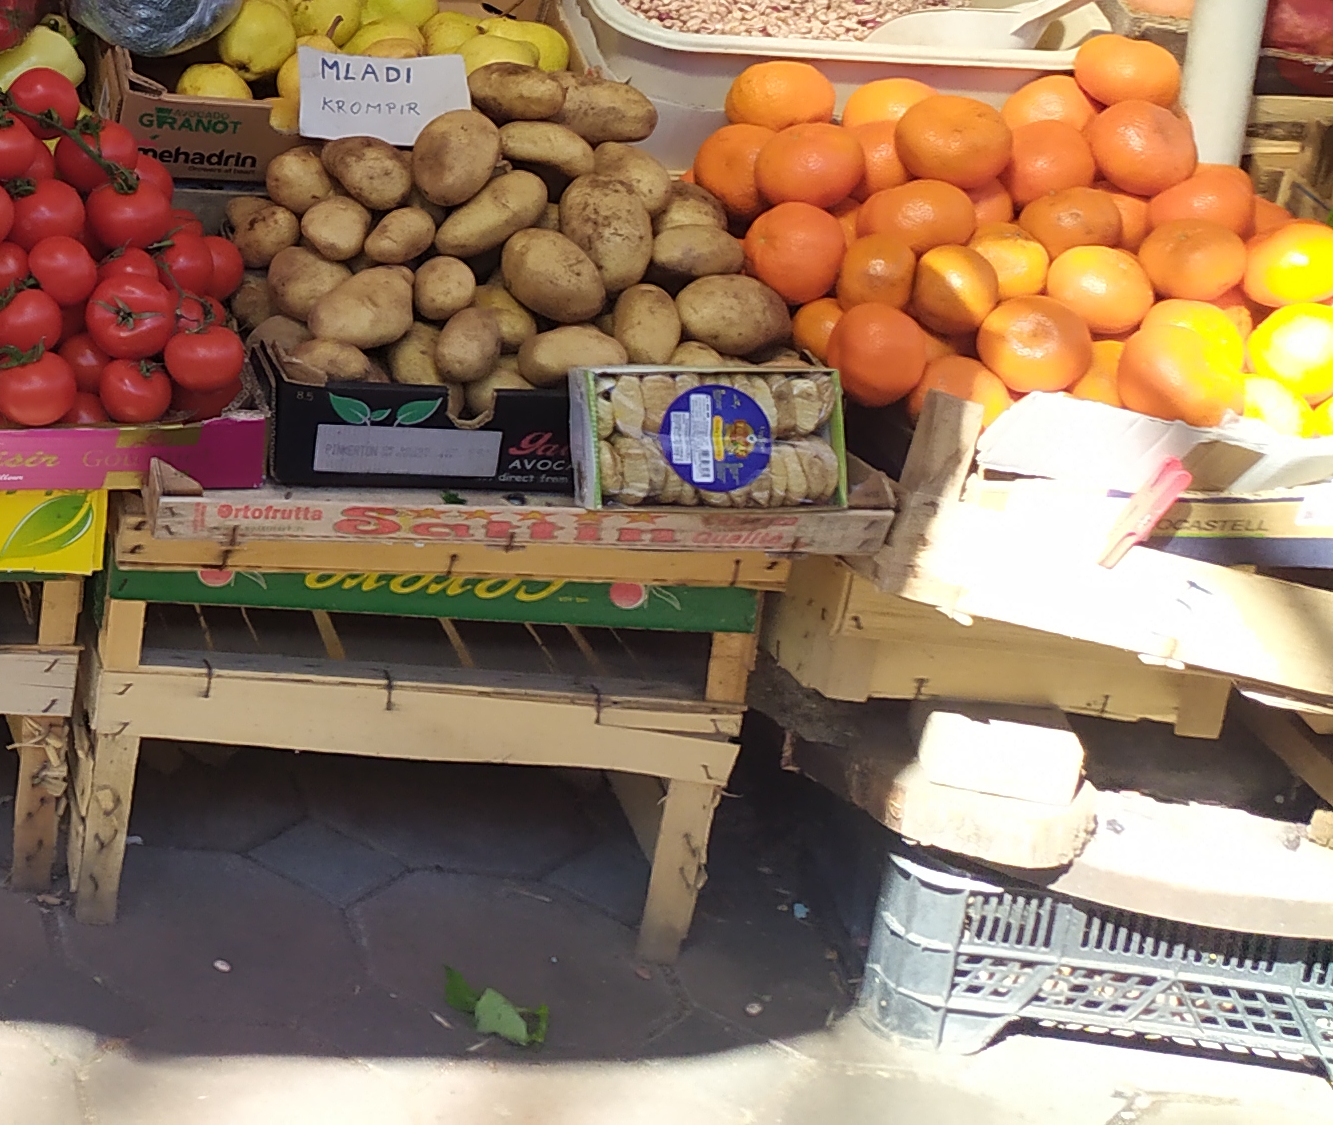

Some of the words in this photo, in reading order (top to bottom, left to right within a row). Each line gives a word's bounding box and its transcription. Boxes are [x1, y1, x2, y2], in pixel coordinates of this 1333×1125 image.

[321, 58, 412, 84] MLADI
[173, 111, 231, 121] AVOCADO
[322, 96, 420, 116] KROMPIR
[138, 112, 243, 135] GRANOT
[137, 147, 257, 168] mehadrin
[498, 475, 534, 483] direct
[217, 503, 323, 521] Ortofrutta
